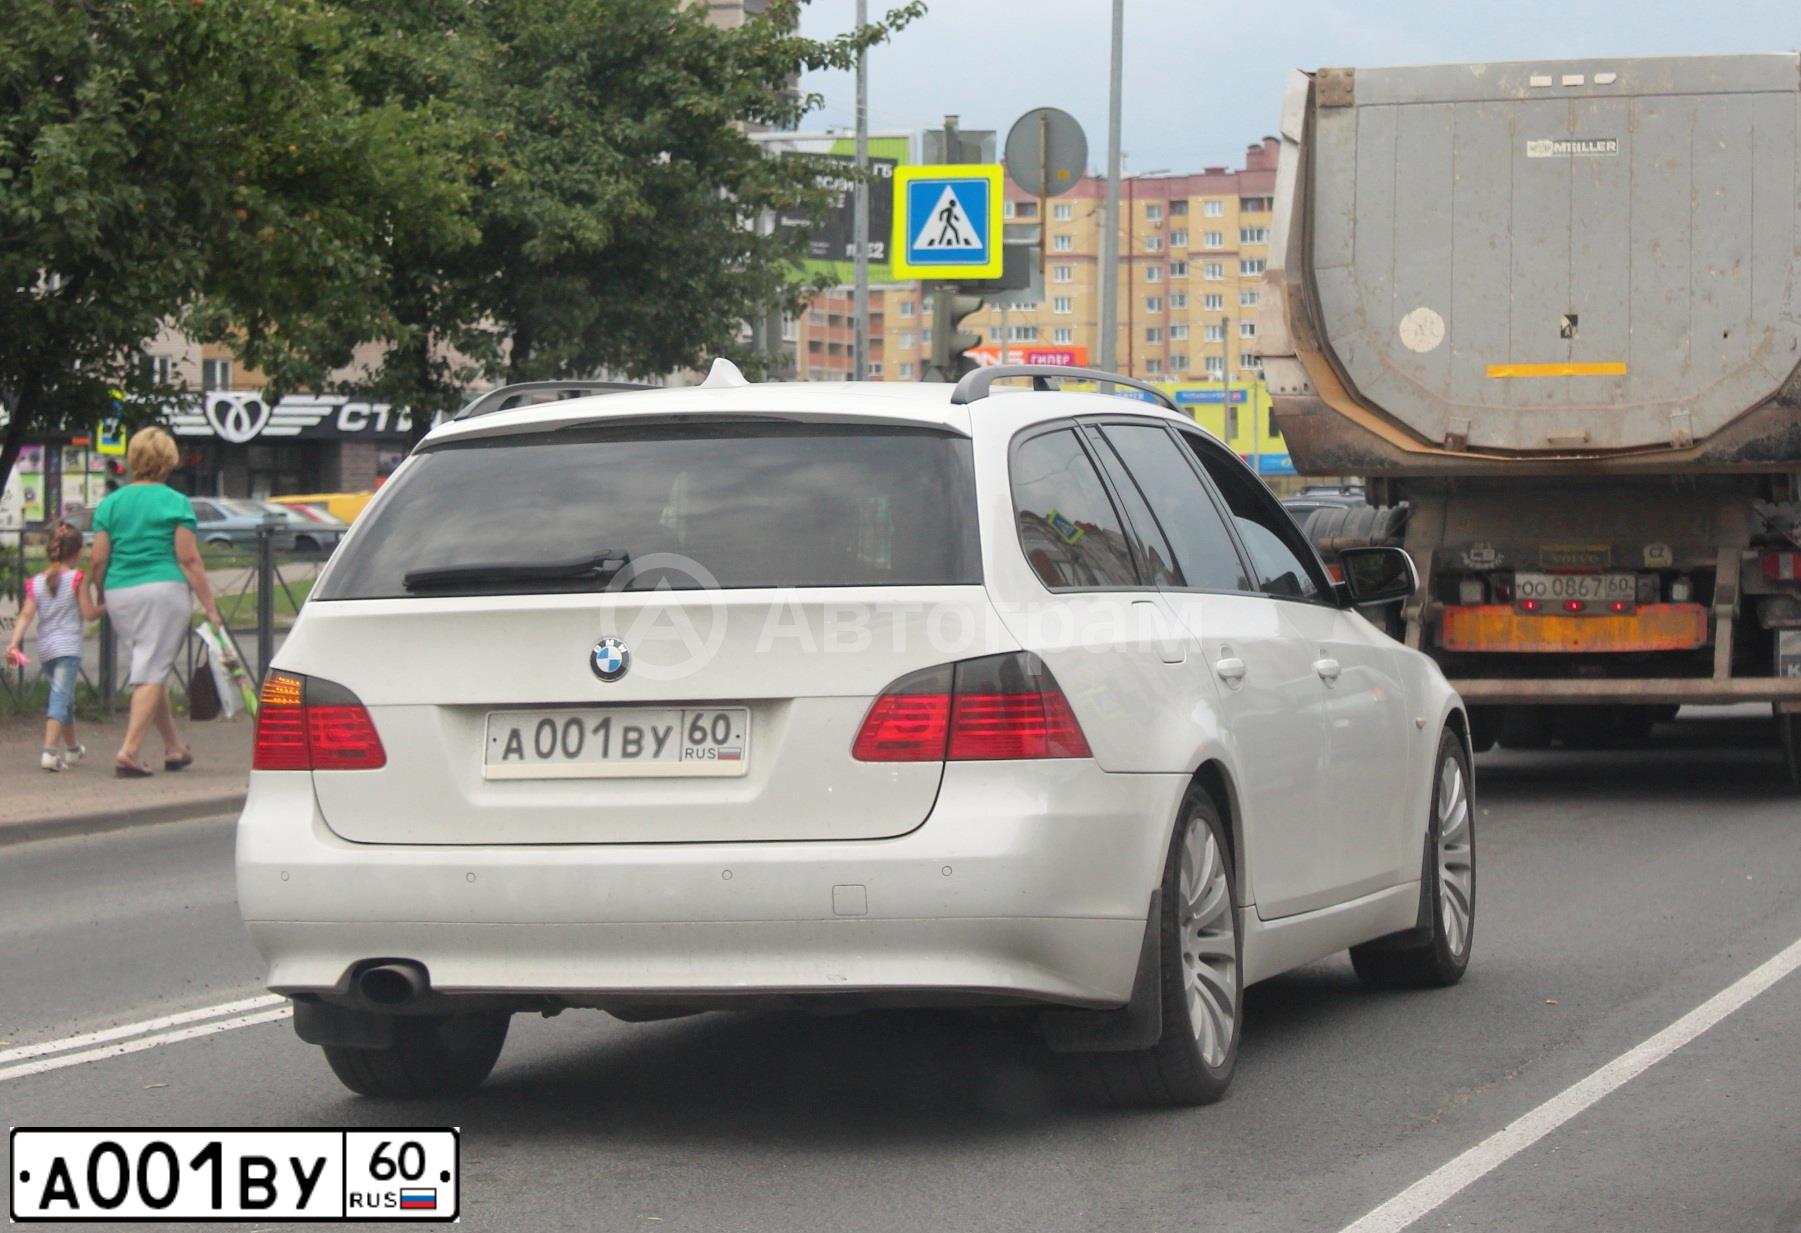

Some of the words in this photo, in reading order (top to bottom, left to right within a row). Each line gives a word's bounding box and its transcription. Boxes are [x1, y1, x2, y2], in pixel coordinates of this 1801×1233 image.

[1030, 353, 1071, 365] ГИПЕР
[1552, 577, 1602, 597] 0867
[1608, 576, 1629, 593] 60
[688, 713, 731, 746] 60
[684, 747, 716, 760] RUS
